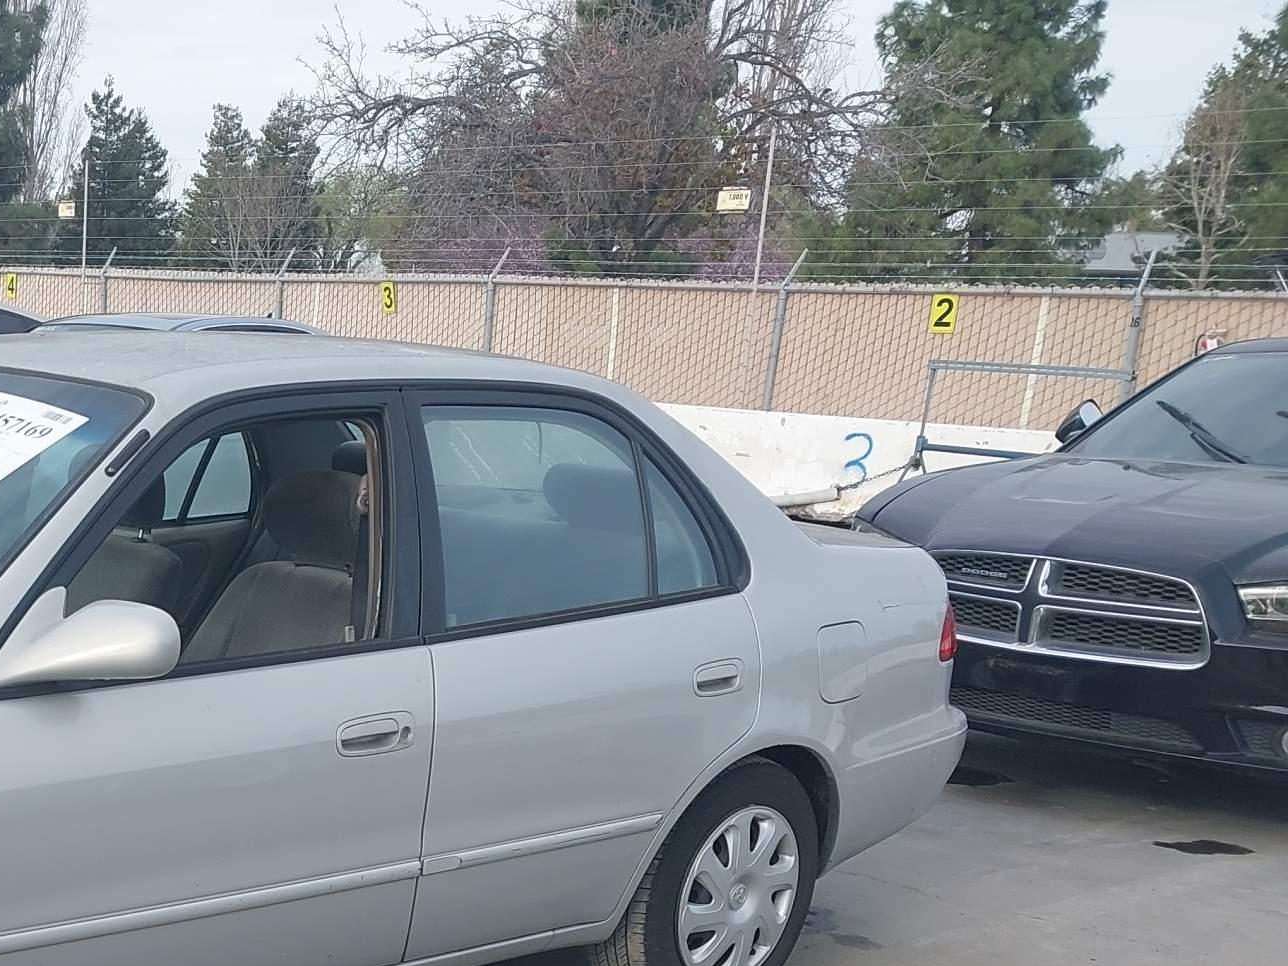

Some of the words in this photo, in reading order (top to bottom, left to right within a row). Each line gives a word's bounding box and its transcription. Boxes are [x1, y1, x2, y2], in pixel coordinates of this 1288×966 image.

[8, 276, 14, 294] 4
[384, 286, 393, 308] 3
[933, 298, 954, 327] 2
[961, 567, 1008, 578] DODGE
